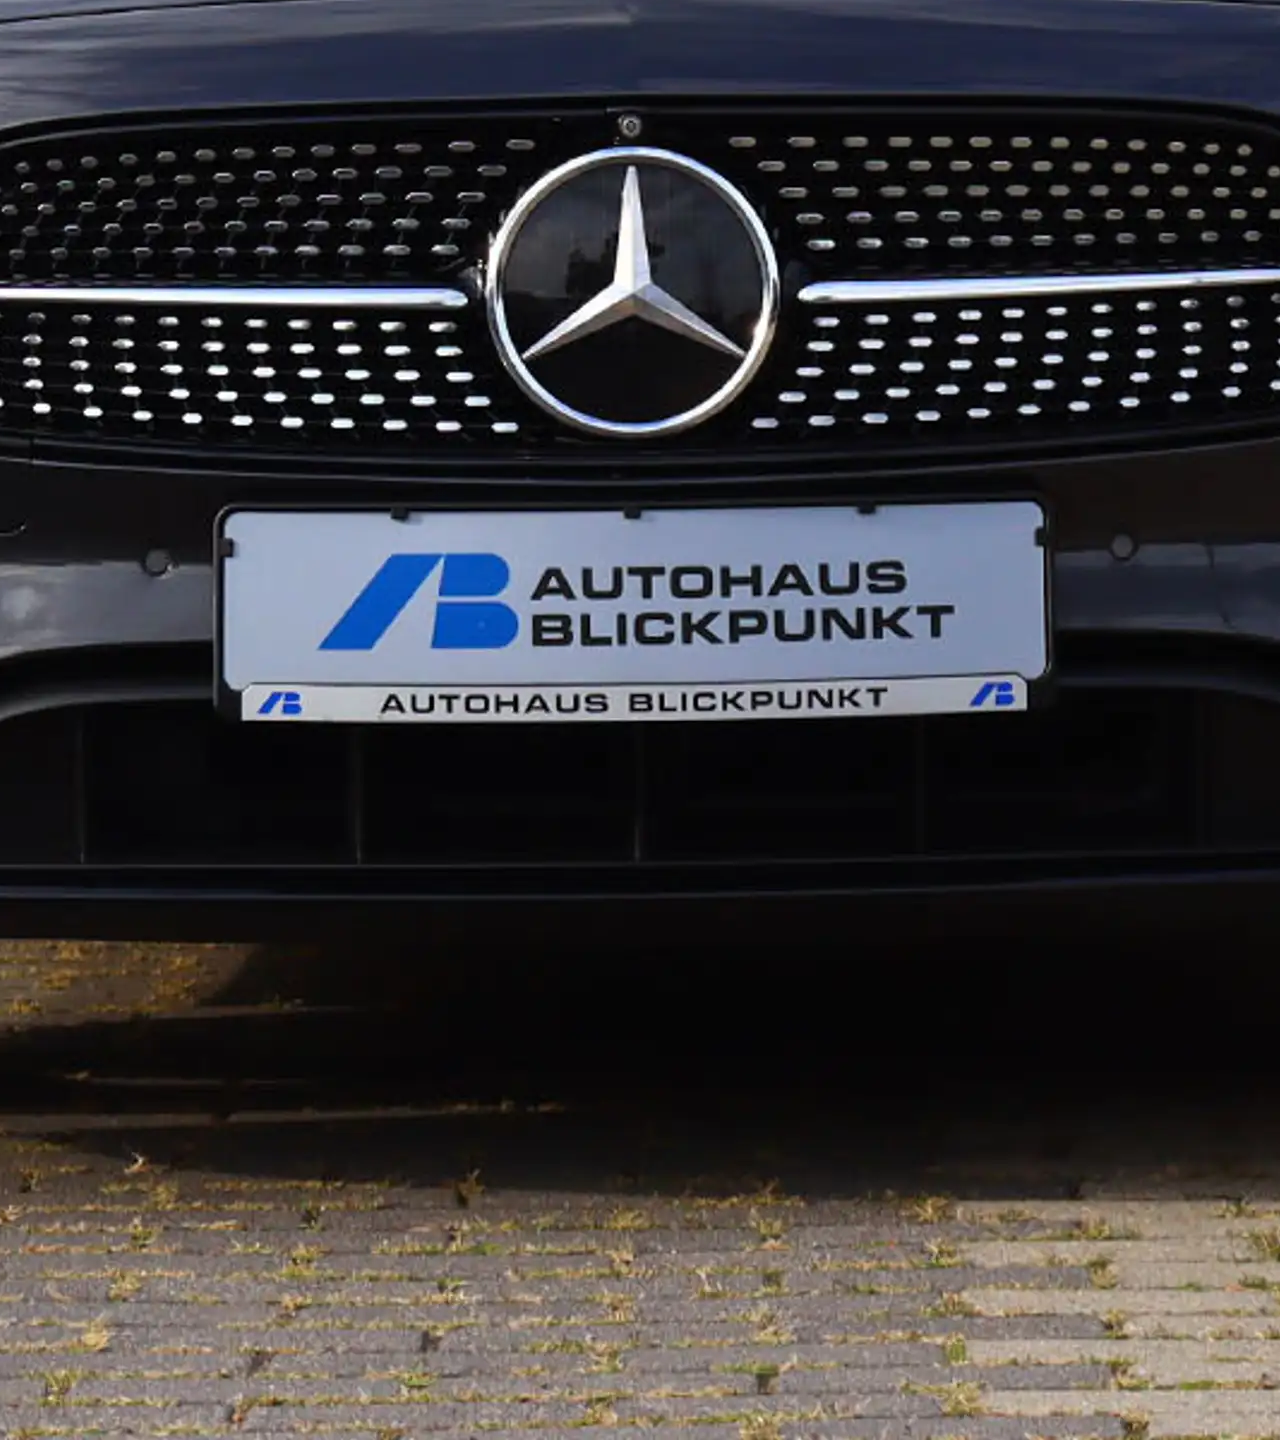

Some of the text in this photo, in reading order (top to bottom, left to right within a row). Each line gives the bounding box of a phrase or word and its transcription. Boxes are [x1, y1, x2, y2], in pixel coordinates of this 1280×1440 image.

[529, 559, 909, 602] AUTOHAUS
[530, 604, 957, 648] BLICKPUNKT
[379, 686, 890, 715] AUTOHAUS BLICKPUNKT
